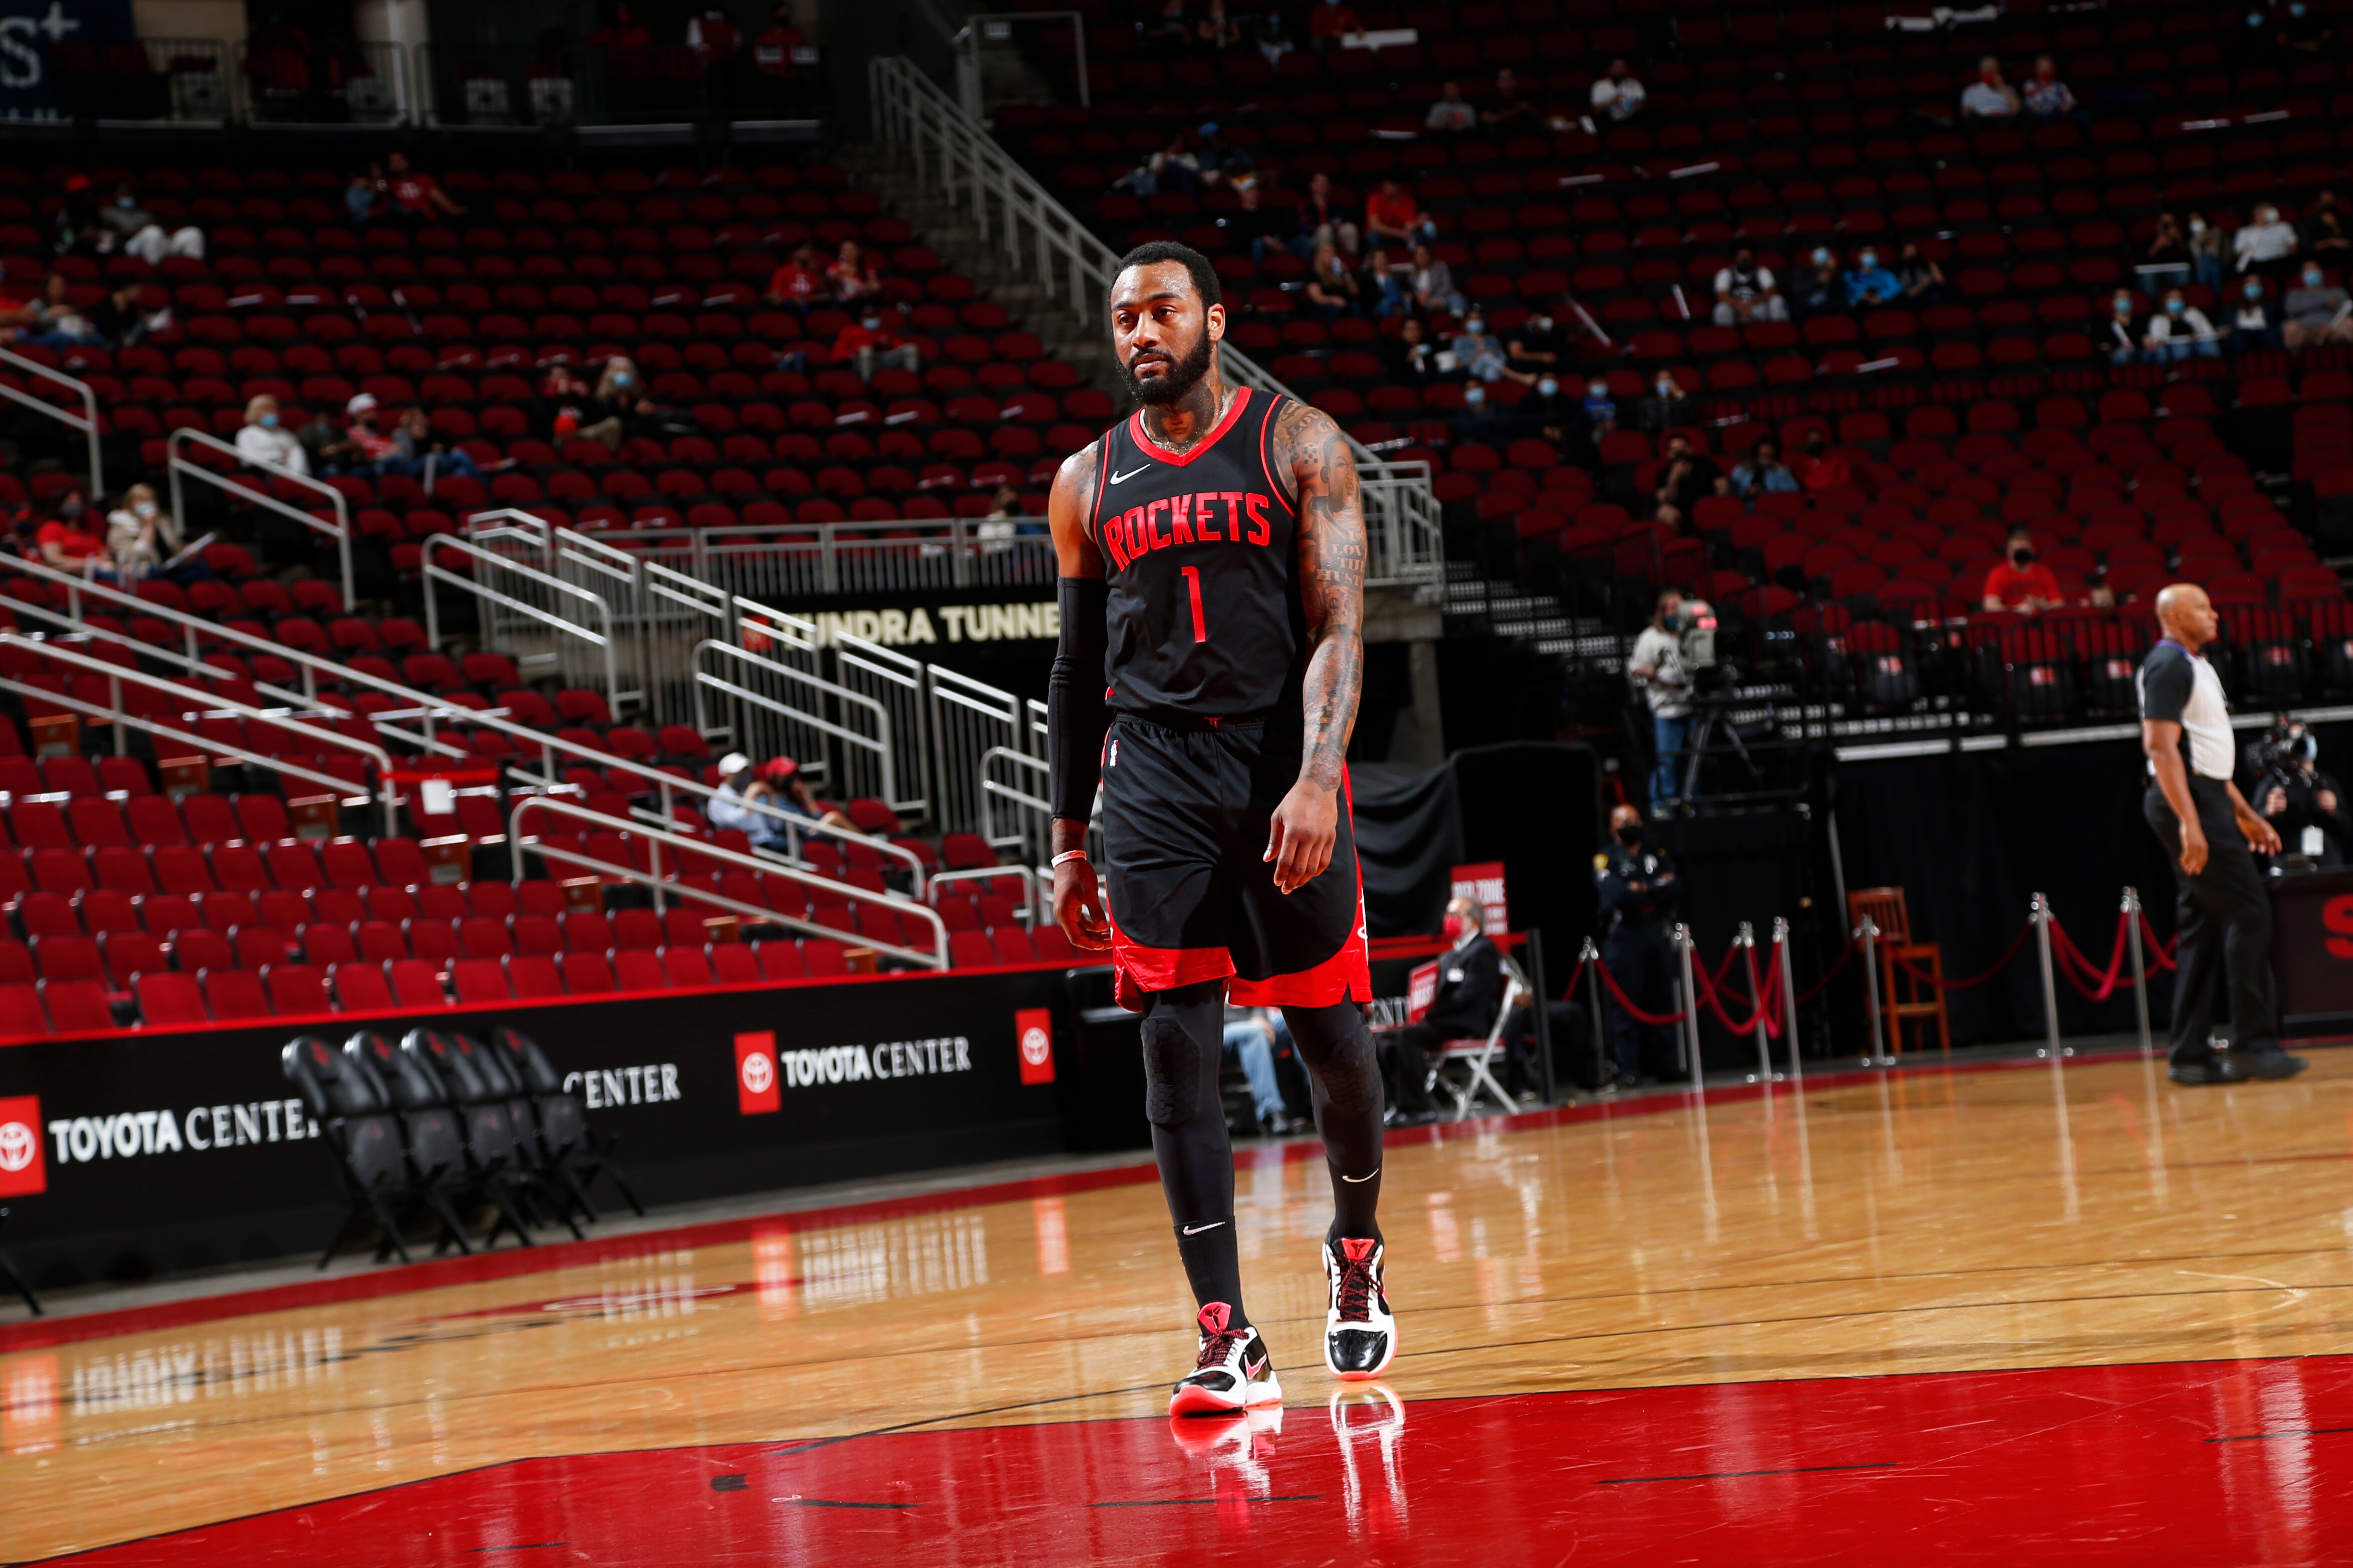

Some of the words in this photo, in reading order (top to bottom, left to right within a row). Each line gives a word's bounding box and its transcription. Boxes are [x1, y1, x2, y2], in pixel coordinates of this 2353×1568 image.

[1103, 491, 1271, 571] ROCKETS
[939, 602, 1059, 643] TUNNE
[1181, 565, 1206, 643] 1
[781, 1044, 872, 1088] TOYOTA
[873, 1036, 972, 1079] CENTER
[49, 1109, 183, 1164] TOYOTA
[185, 1098, 322, 1150] CENTE
